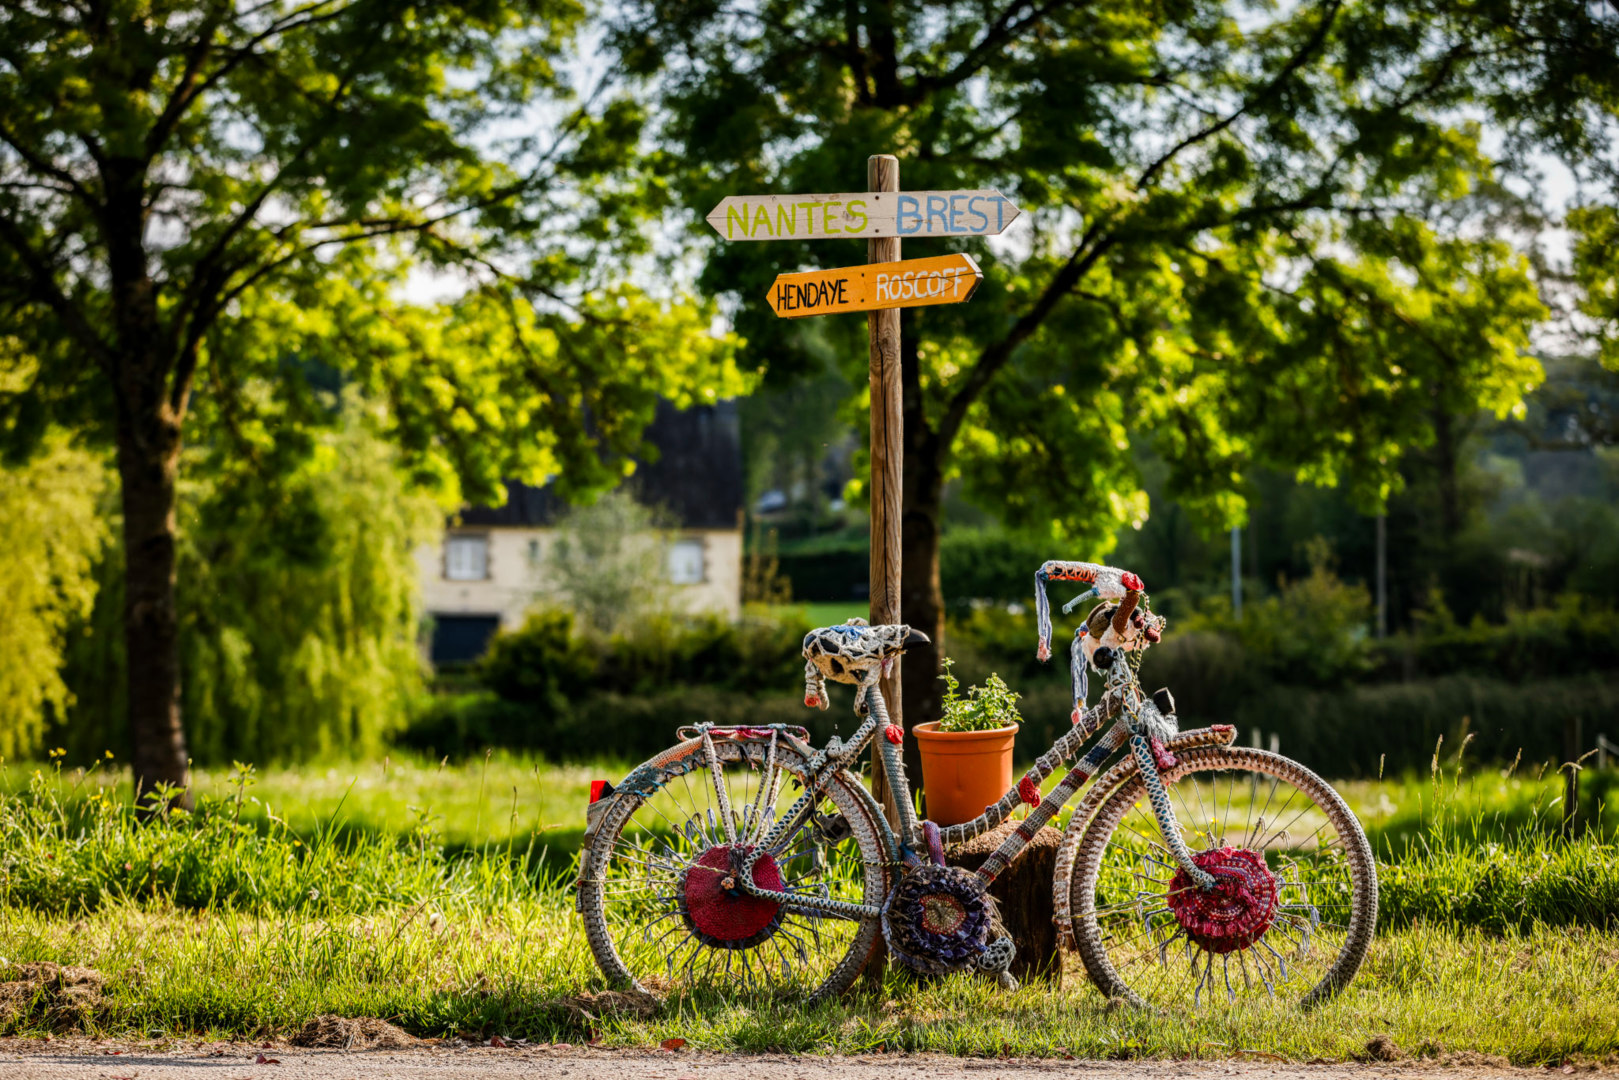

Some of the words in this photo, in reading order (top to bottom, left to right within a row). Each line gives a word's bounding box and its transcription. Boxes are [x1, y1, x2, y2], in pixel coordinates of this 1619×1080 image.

[726, 199, 868, 239] NANTES
[896, 194, 1007, 235] BREST
[776, 278, 849, 311] HENDAYE
[876, 266, 968, 301] ROSCOFF
